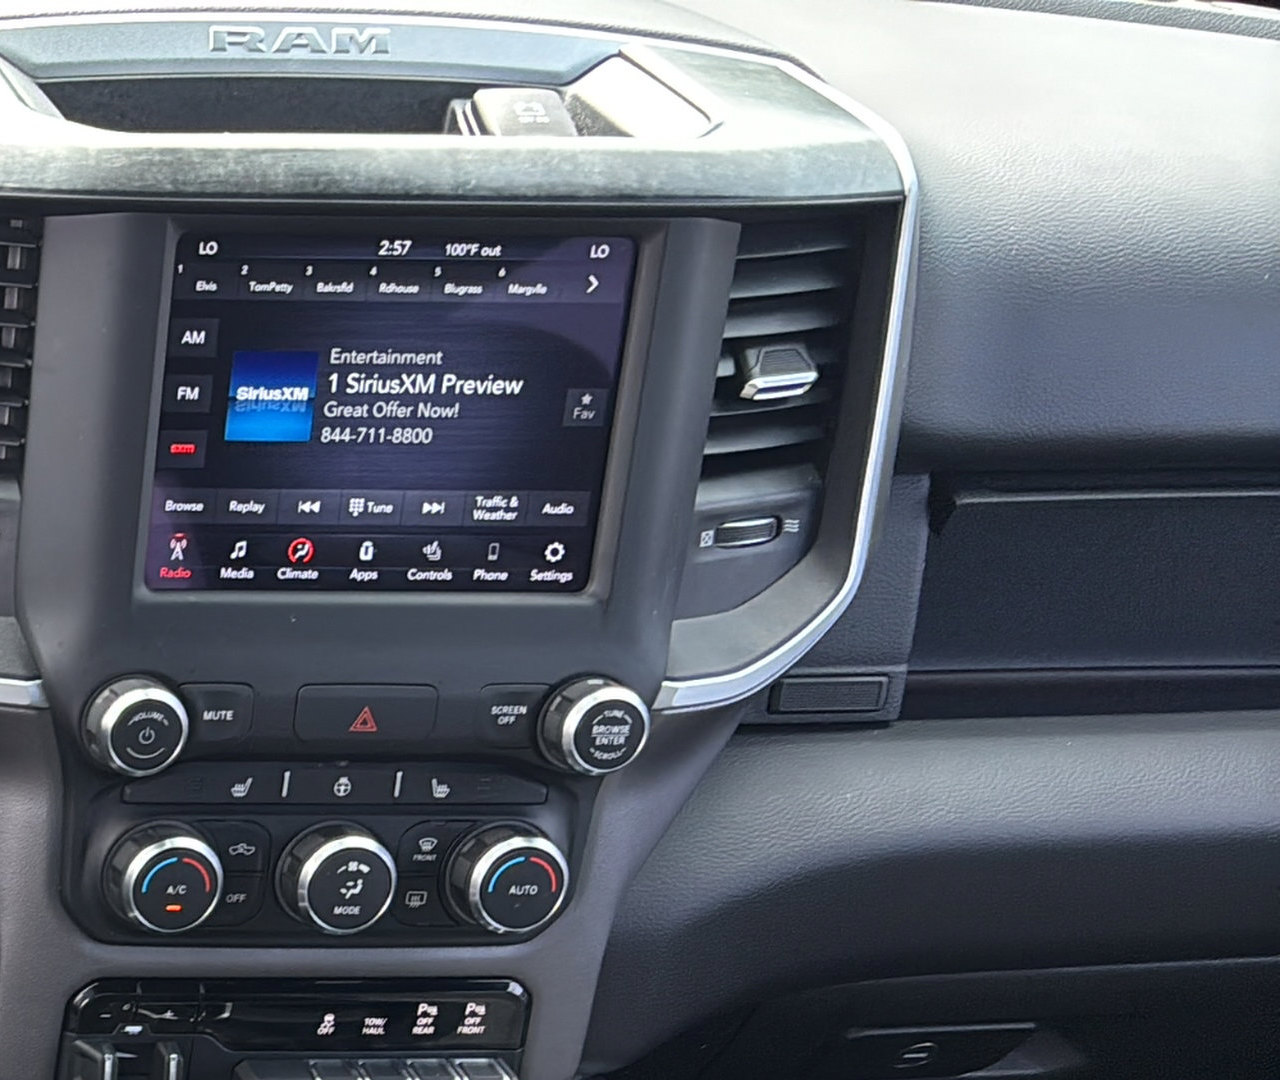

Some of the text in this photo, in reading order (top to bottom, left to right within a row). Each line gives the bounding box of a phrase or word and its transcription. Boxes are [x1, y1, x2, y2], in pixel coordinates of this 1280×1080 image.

[208, 25, 391, 54] RAM
[198, 241, 218, 255] LO
[378, 240, 412, 256] 2:57
[481, 245, 502, 256] out
[591, 244, 609, 258] LO
[178, 264, 183, 274] 1
[241, 265, 249, 275] 2
[305, 265, 313, 276] 3
[370, 266, 377, 276] 4
[434, 266, 441, 277] 5
[498, 267, 506, 277] 6
[196, 281, 217, 291] Elvis
[249, 281, 294, 294] TomPetty
[181, 330, 206, 344] AM
[330, 348, 443, 365] Entertainment
[328, 373, 524, 395] 1 SiriusXM Preview
[177, 386, 199, 400] FM
[236, 386, 309, 401] SiriusXM
[324, 401, 460, 418] Great Offer Now!
[573, 408, 596, 420] Fav
[321, 427, 433, 444] 844-711-8800
[165, 500, 204, 512] Browse
[229, 500, 265, 514] Replay
[476, 496, 519, 508] Traffic &
[367, 502, 393, 514] Tune
[542, 503, 574, 515] Audio
[473, 509, 518, 521] Weather
[159, 567, 191, 578] Radio
[220, 568, 254, 579] Media
[277, 568, 319, 580] Climate
[349, 569, 378, 582] Apps
[407, 568, 452, 581] Controls
[473, 569, 508, 581] Phone
[530, 569, 573, 583] Settings
[203, 710, 234, 720] MUTE
[491, 705, 527, 715] SCREEN
[498, 715, 516, 725] OFF
[592, 724, 631, 734] BROWSE
[595, 736, 625, 745] ENTER
[413, 853, 436, 861] FRONT
[166, 885, 187, 894] A/C
[508, 885, 538, 896] AUTO
[226, 893, 247, 902] OFF
[333, 905, 361, 915] MODE
[417, 1017, 434, 1025] OFF
[464, 1017, 482, 1025] OFF
[317, 1026, 335, 1035] OFF
[362, 1027, 385, 1035] HAUL
[412, 1026, 434, 1034] REAR
[457, 1026, 486, 1034] FRONT
